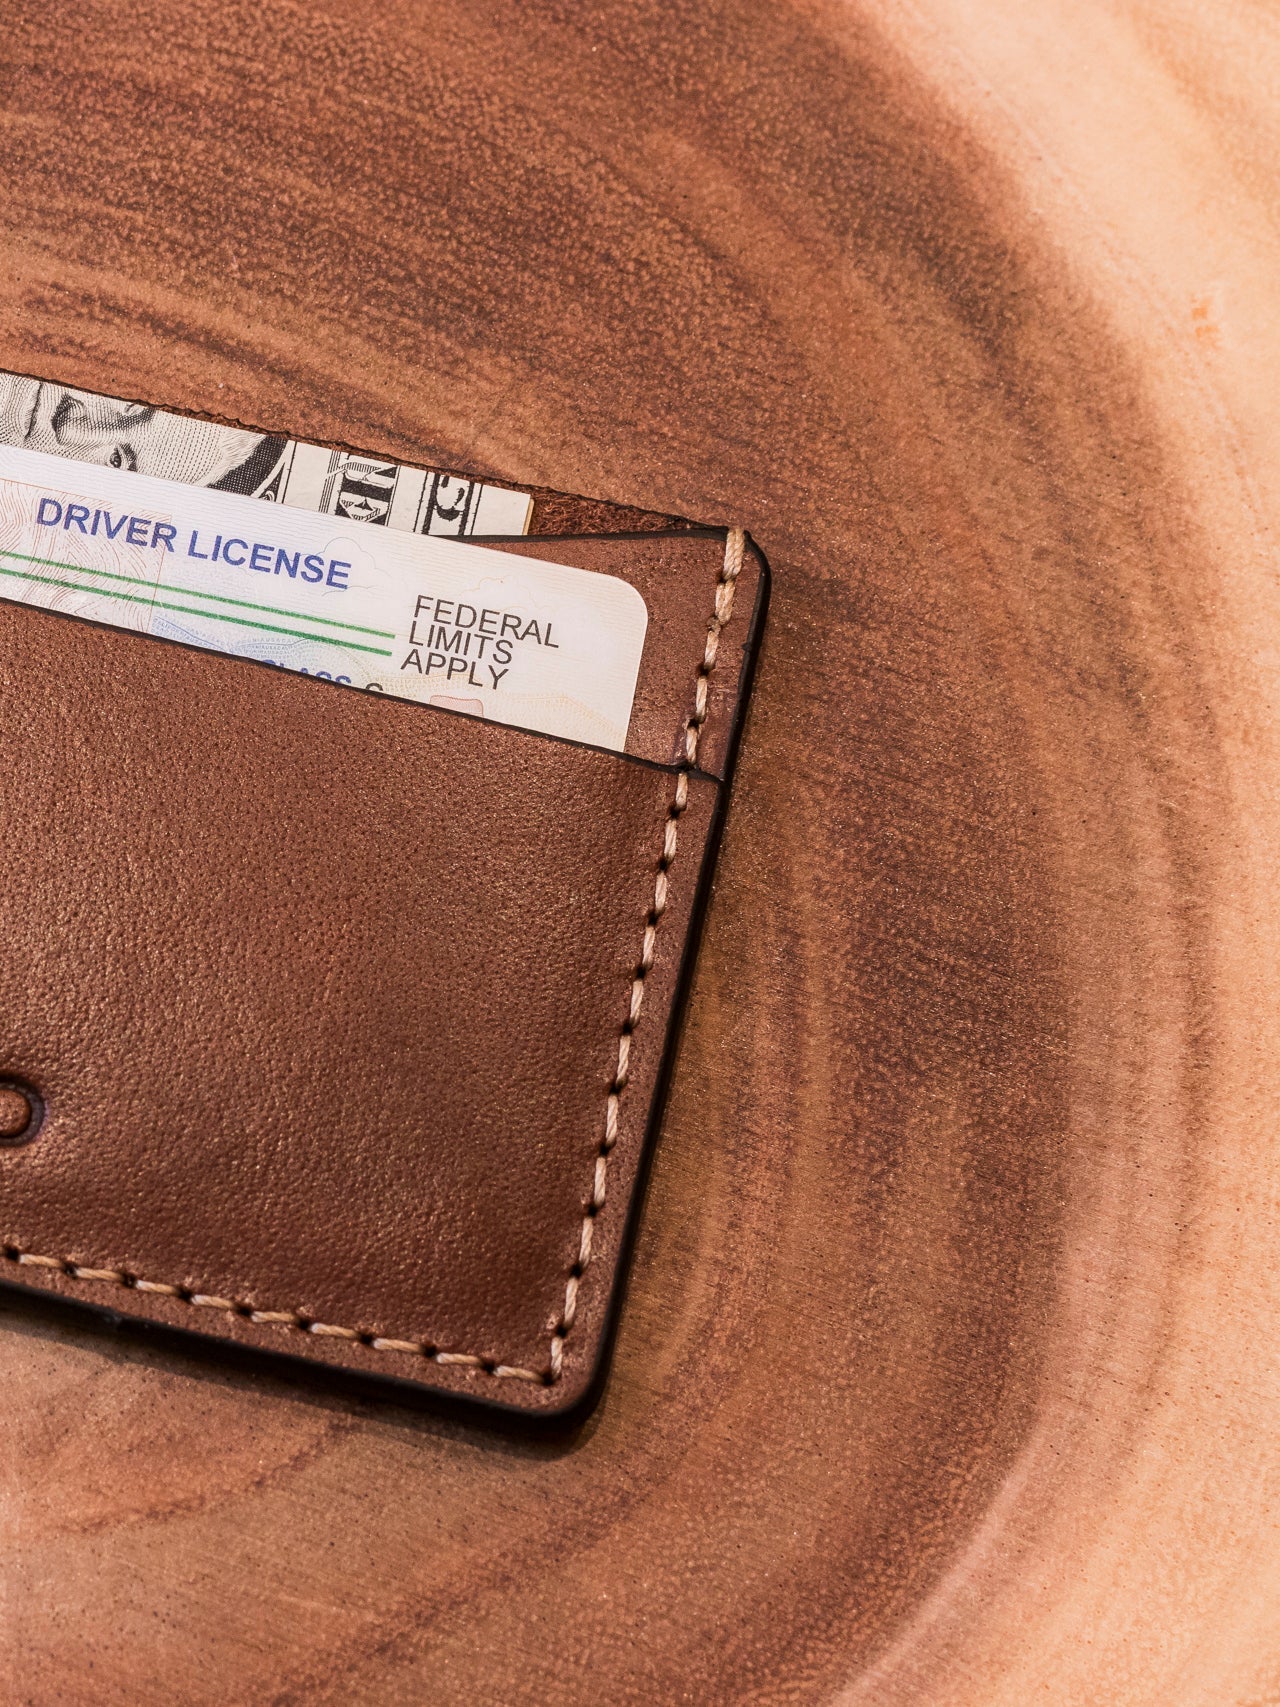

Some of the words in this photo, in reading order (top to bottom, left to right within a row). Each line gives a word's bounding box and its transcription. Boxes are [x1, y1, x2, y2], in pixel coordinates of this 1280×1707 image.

[36, 497, 177, 553] DRIVER
[187, 529, 352, 590] LICENSE
[408, 620, 513, 665] LIMITS
[413, 594, 559, 648] FEDERAL
[400, 648, 509, 690] APPLY
